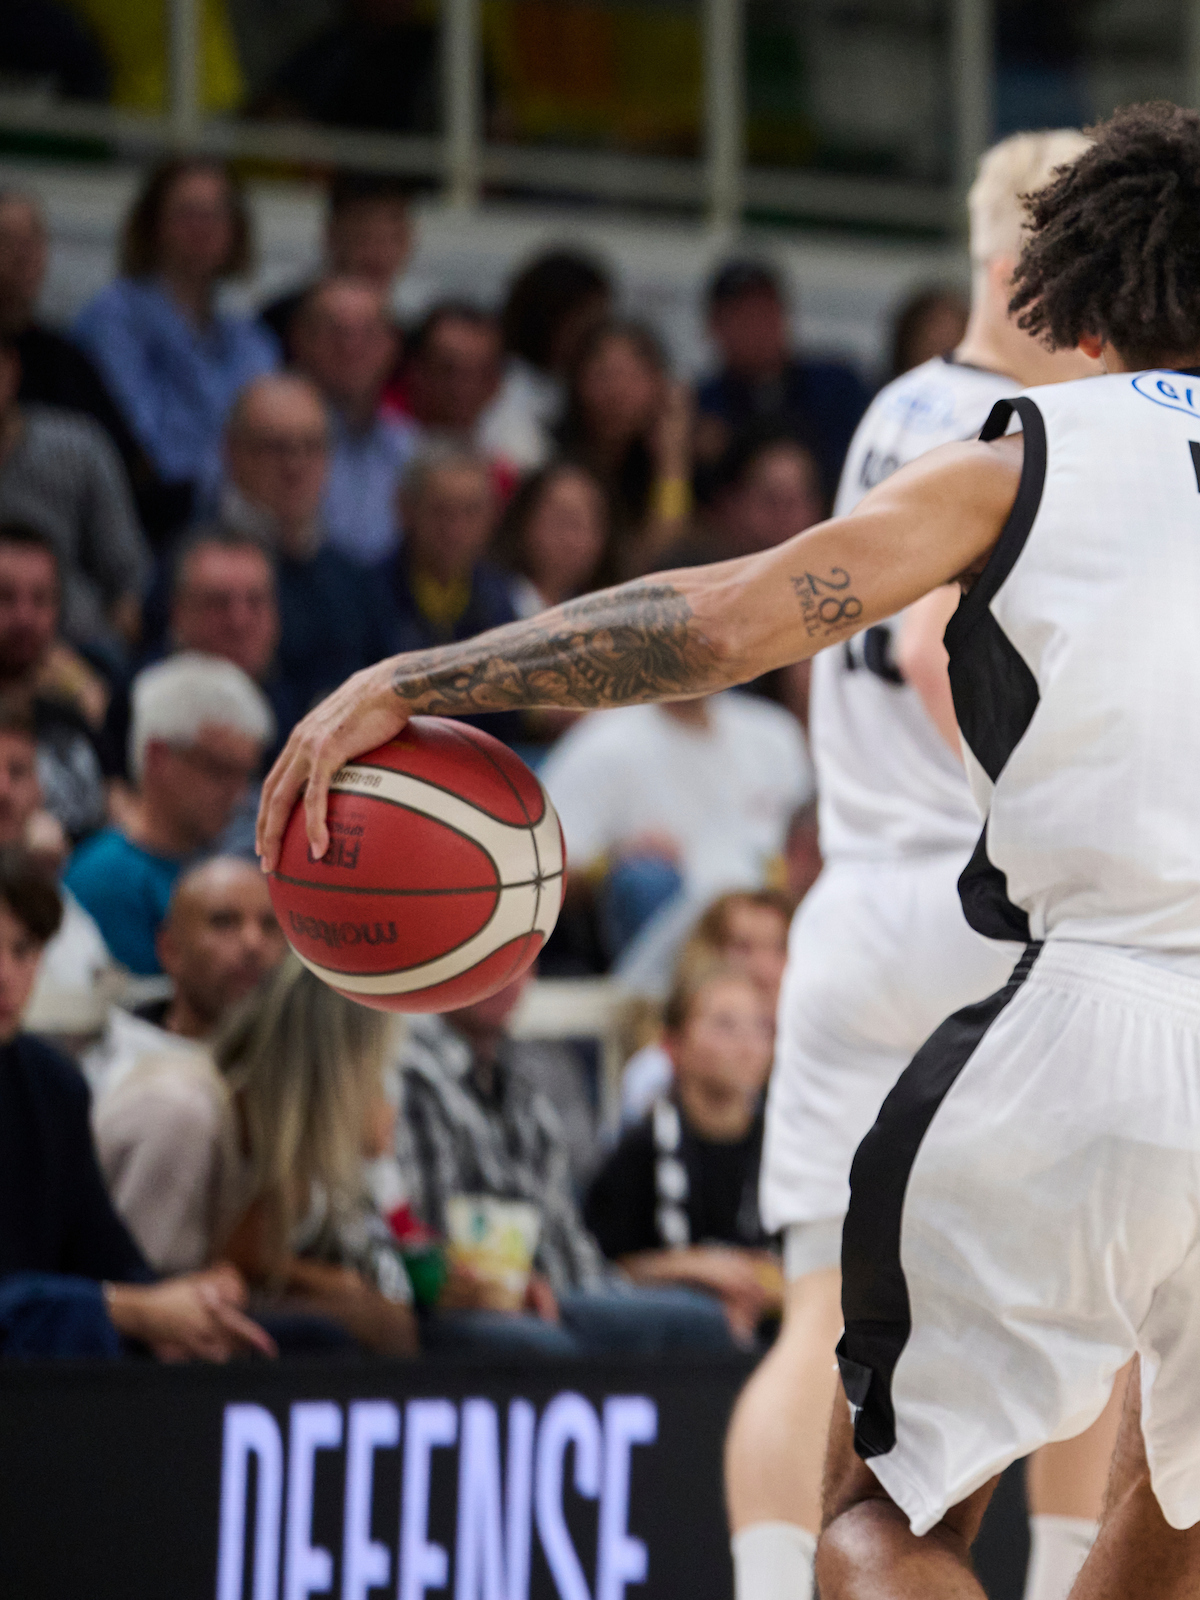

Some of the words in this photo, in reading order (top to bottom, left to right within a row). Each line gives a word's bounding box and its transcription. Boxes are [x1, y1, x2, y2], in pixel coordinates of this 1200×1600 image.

[804, 566, 863, 624] 28
[288, 909, 399, 950] molten
[216, 1390, 658, 1600] DEFENSE
